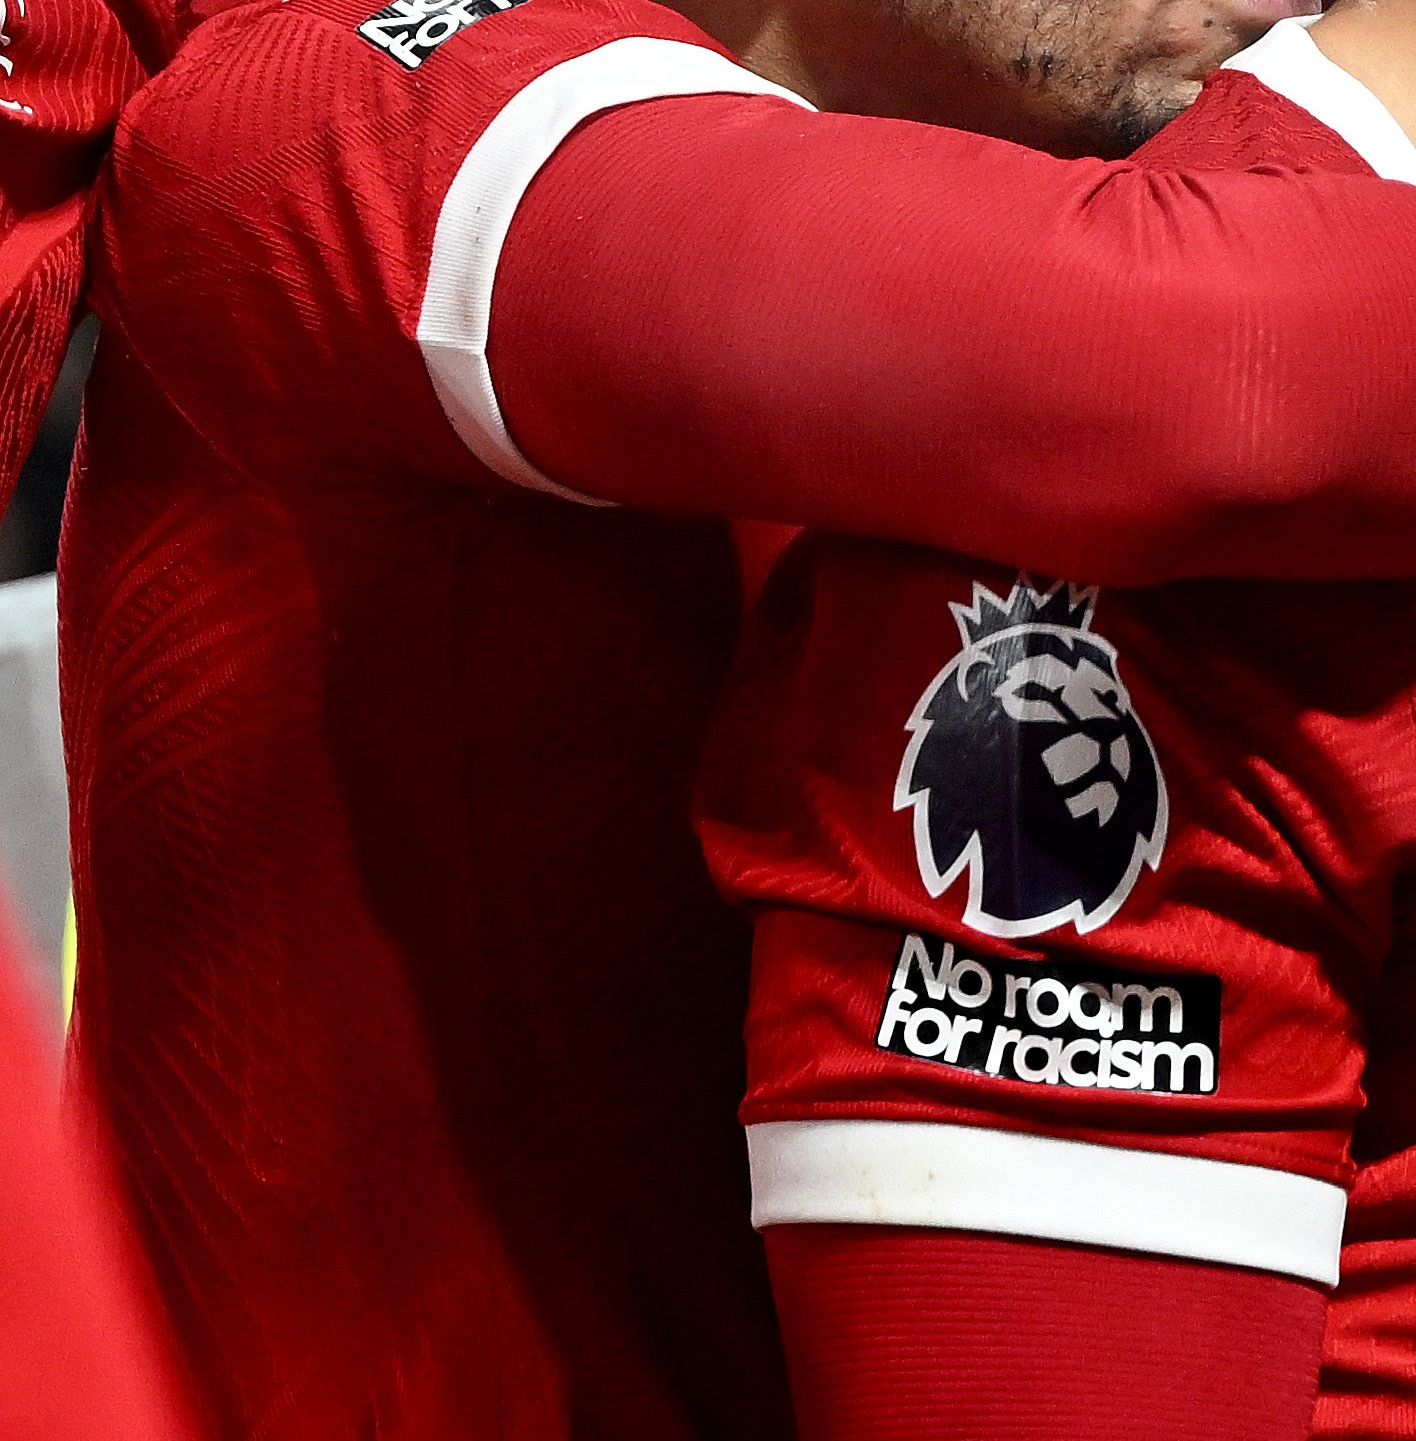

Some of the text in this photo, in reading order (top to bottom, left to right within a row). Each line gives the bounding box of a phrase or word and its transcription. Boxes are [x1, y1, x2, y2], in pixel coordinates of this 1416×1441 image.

[891, 934, 1184, 1038] No room
[877, 988, 1215, 1092] for racism
